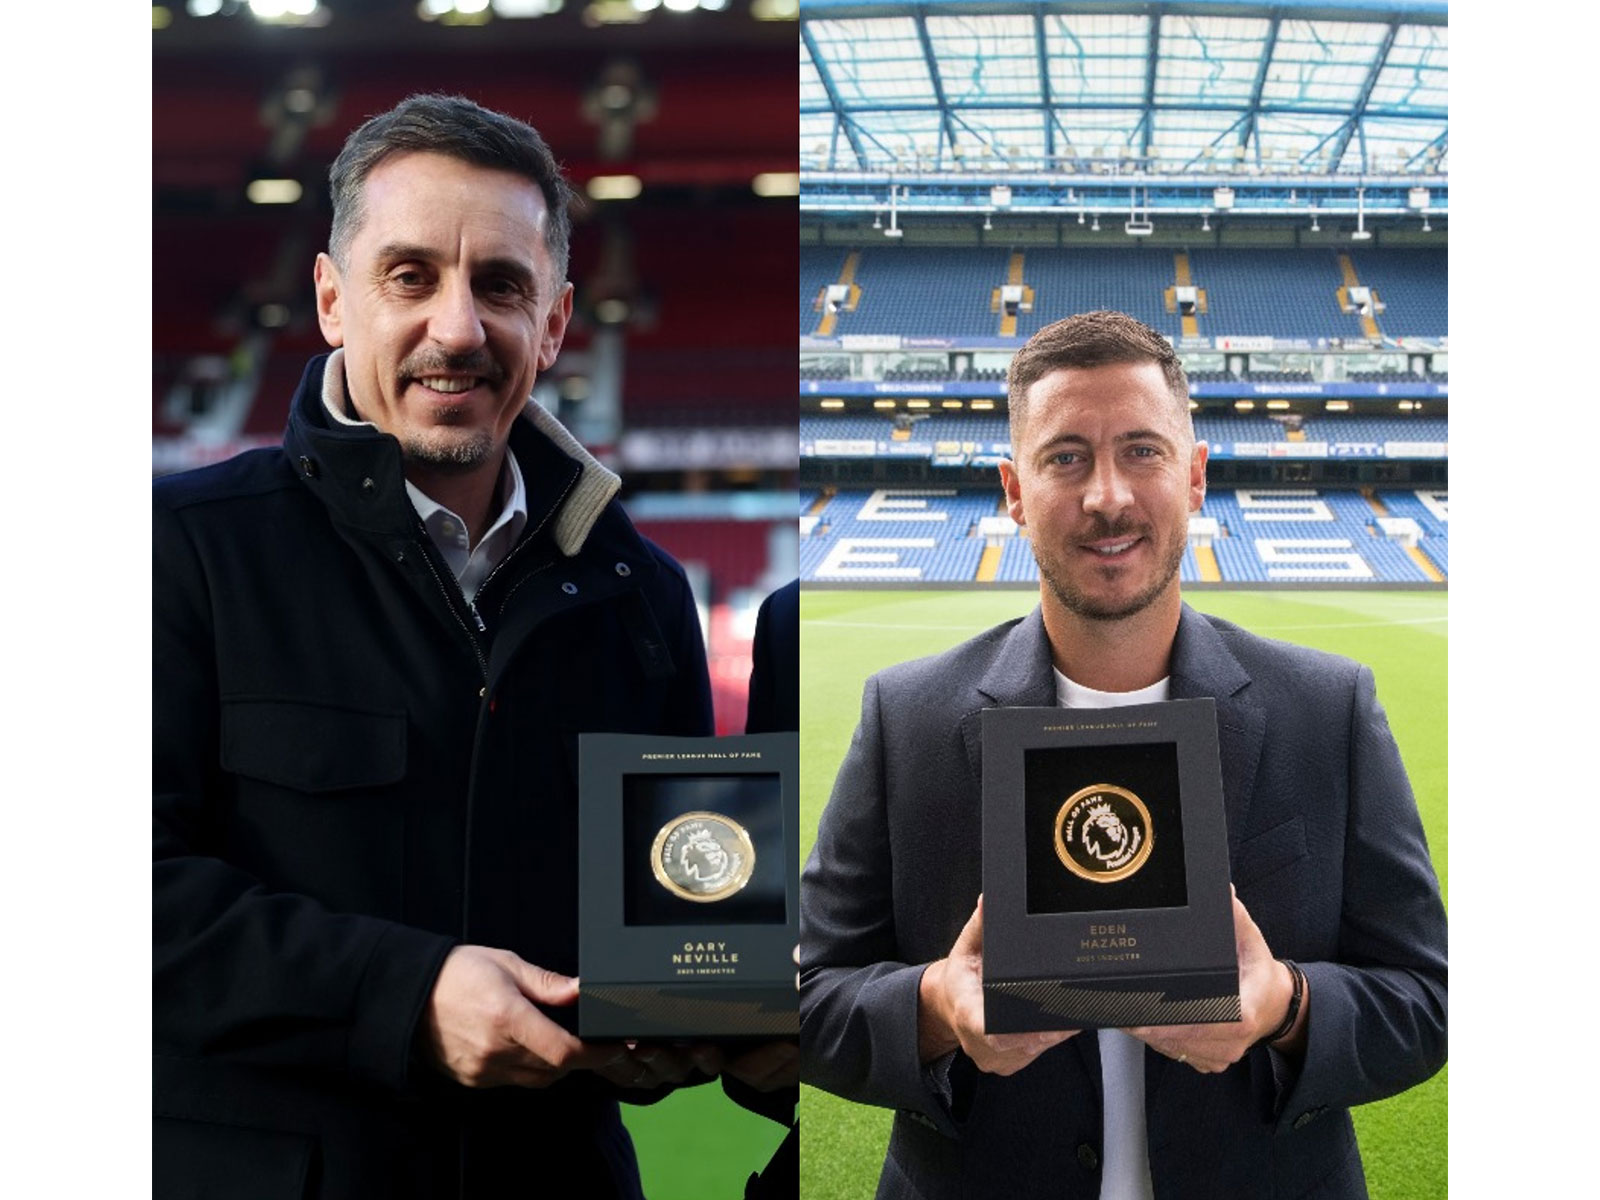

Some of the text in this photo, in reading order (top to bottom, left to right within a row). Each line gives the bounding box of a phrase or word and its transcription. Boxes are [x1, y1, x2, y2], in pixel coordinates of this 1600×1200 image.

[1090, 924, 1126, 935] EDEN
[684, 942, 725, 952] GARY
[1080, 937, 1137, 949] HAZARD
[673, 953, 739, 963] NEVILLE
